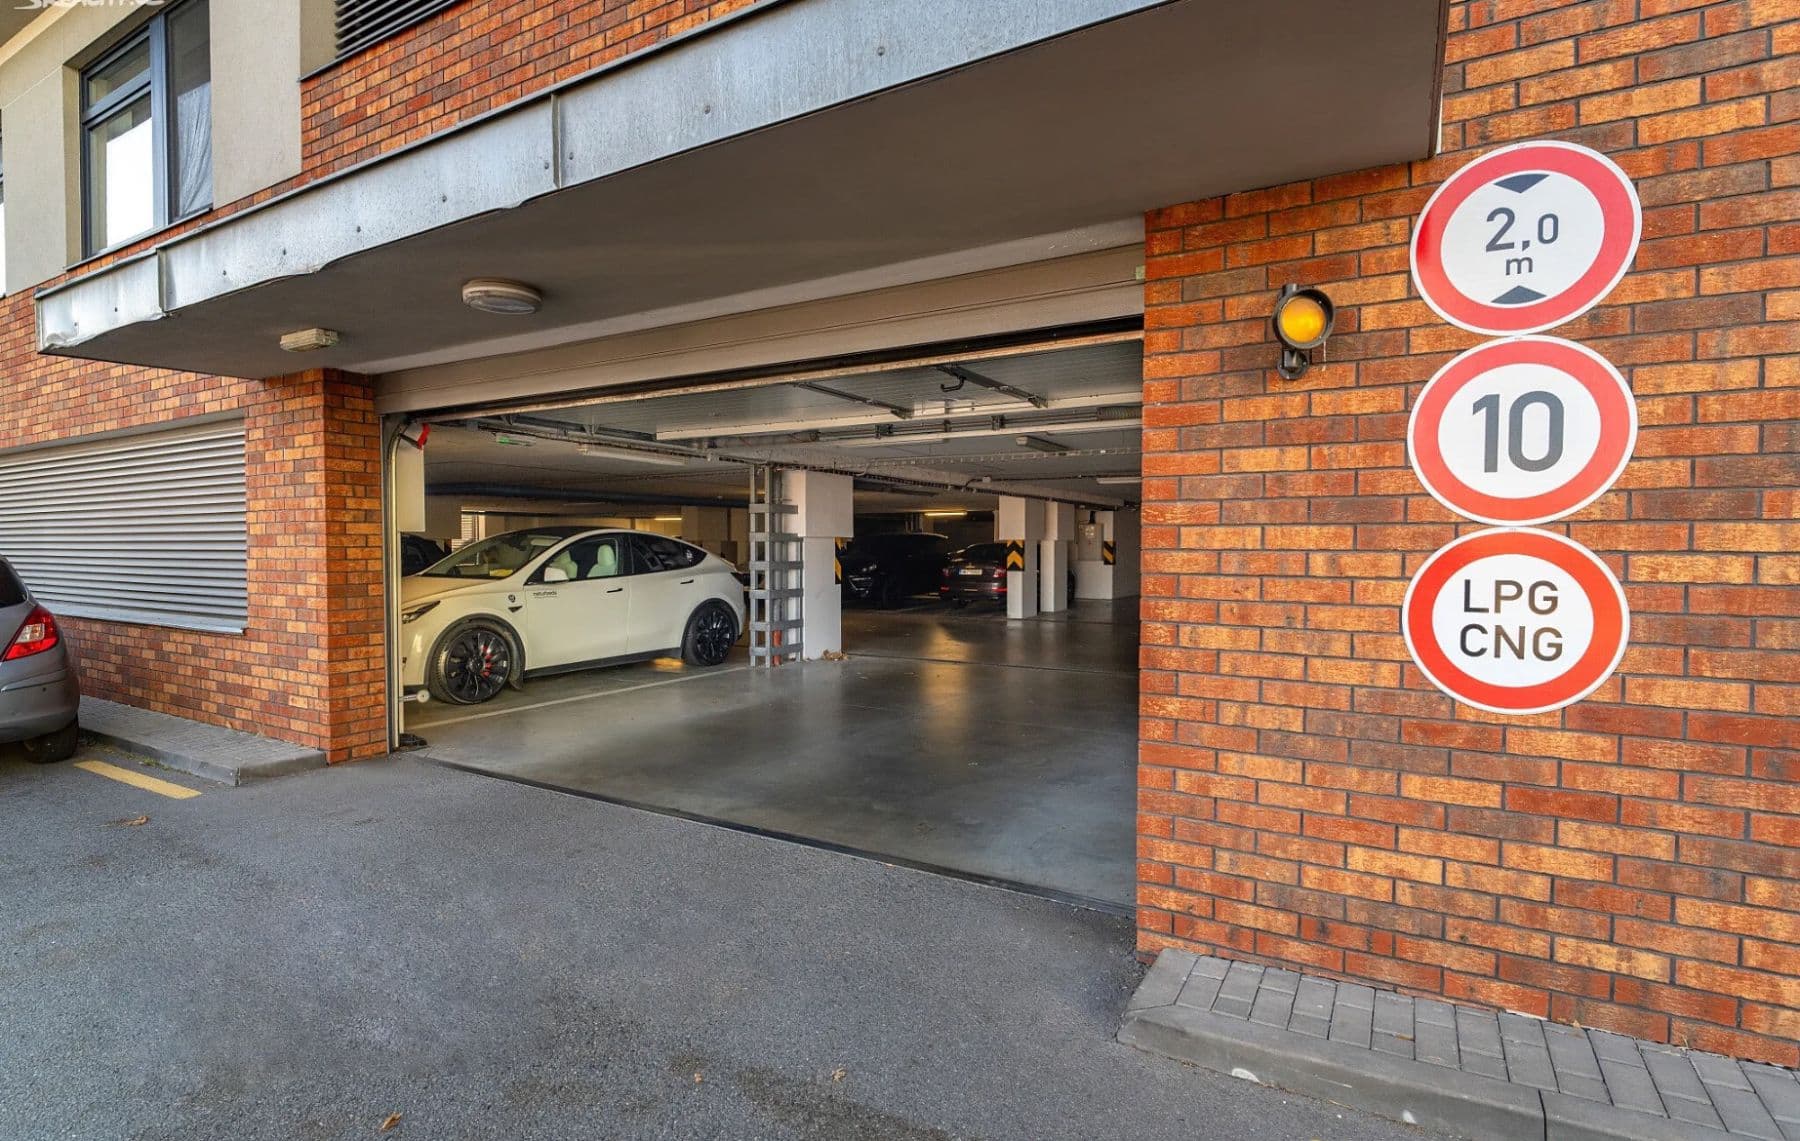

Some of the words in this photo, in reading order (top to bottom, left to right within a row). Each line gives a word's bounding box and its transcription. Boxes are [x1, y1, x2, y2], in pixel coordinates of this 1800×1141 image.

[1485, 206, 1559, 253] 2,0
[1506, 257, 1534, 276] m
[1472, 390, 1565, 473] 10
[1463, 578, 1559, 616] LPG
[1459, 623, 1563, 662] CNG
